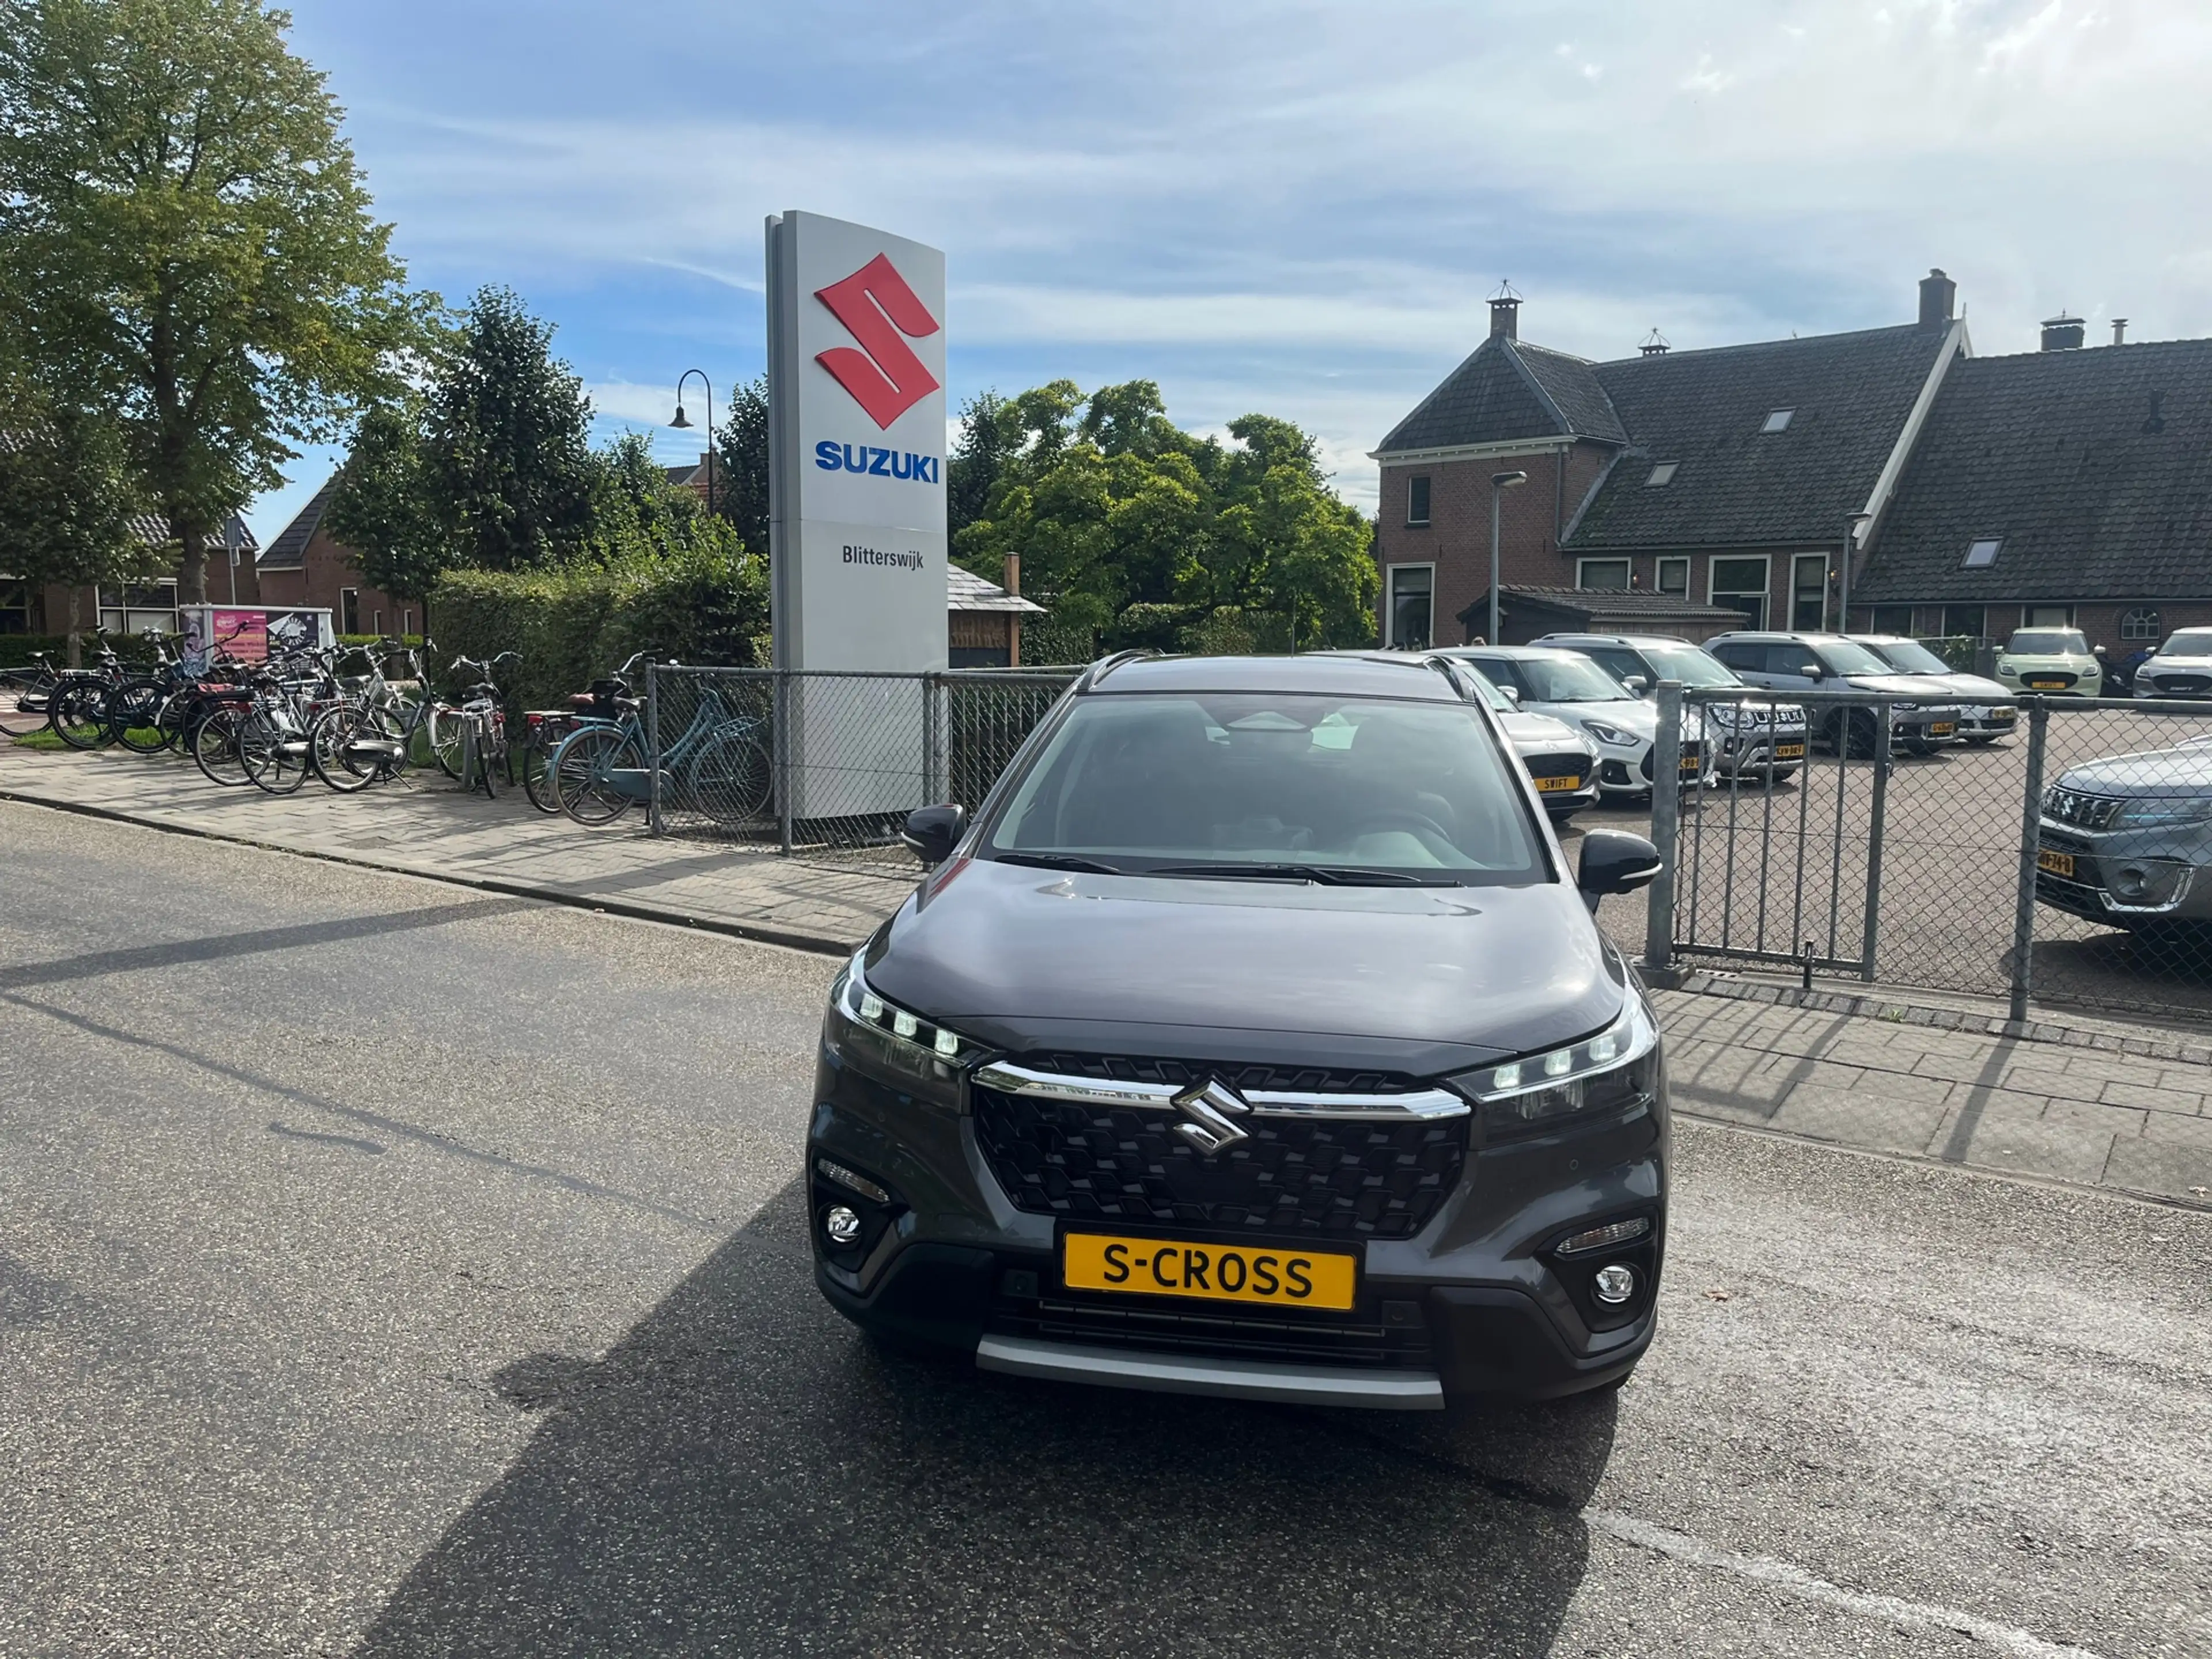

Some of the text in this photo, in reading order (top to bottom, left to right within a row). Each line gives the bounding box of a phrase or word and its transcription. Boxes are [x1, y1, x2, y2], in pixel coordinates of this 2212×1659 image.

[815, 441, 938, 484] SUZUKI
[843, 545, 924, 571] Blitterswijk
[1544, 778, 1568, 789] SWIFT
[1103, 1244, 1313, 1298] S-CROSS
